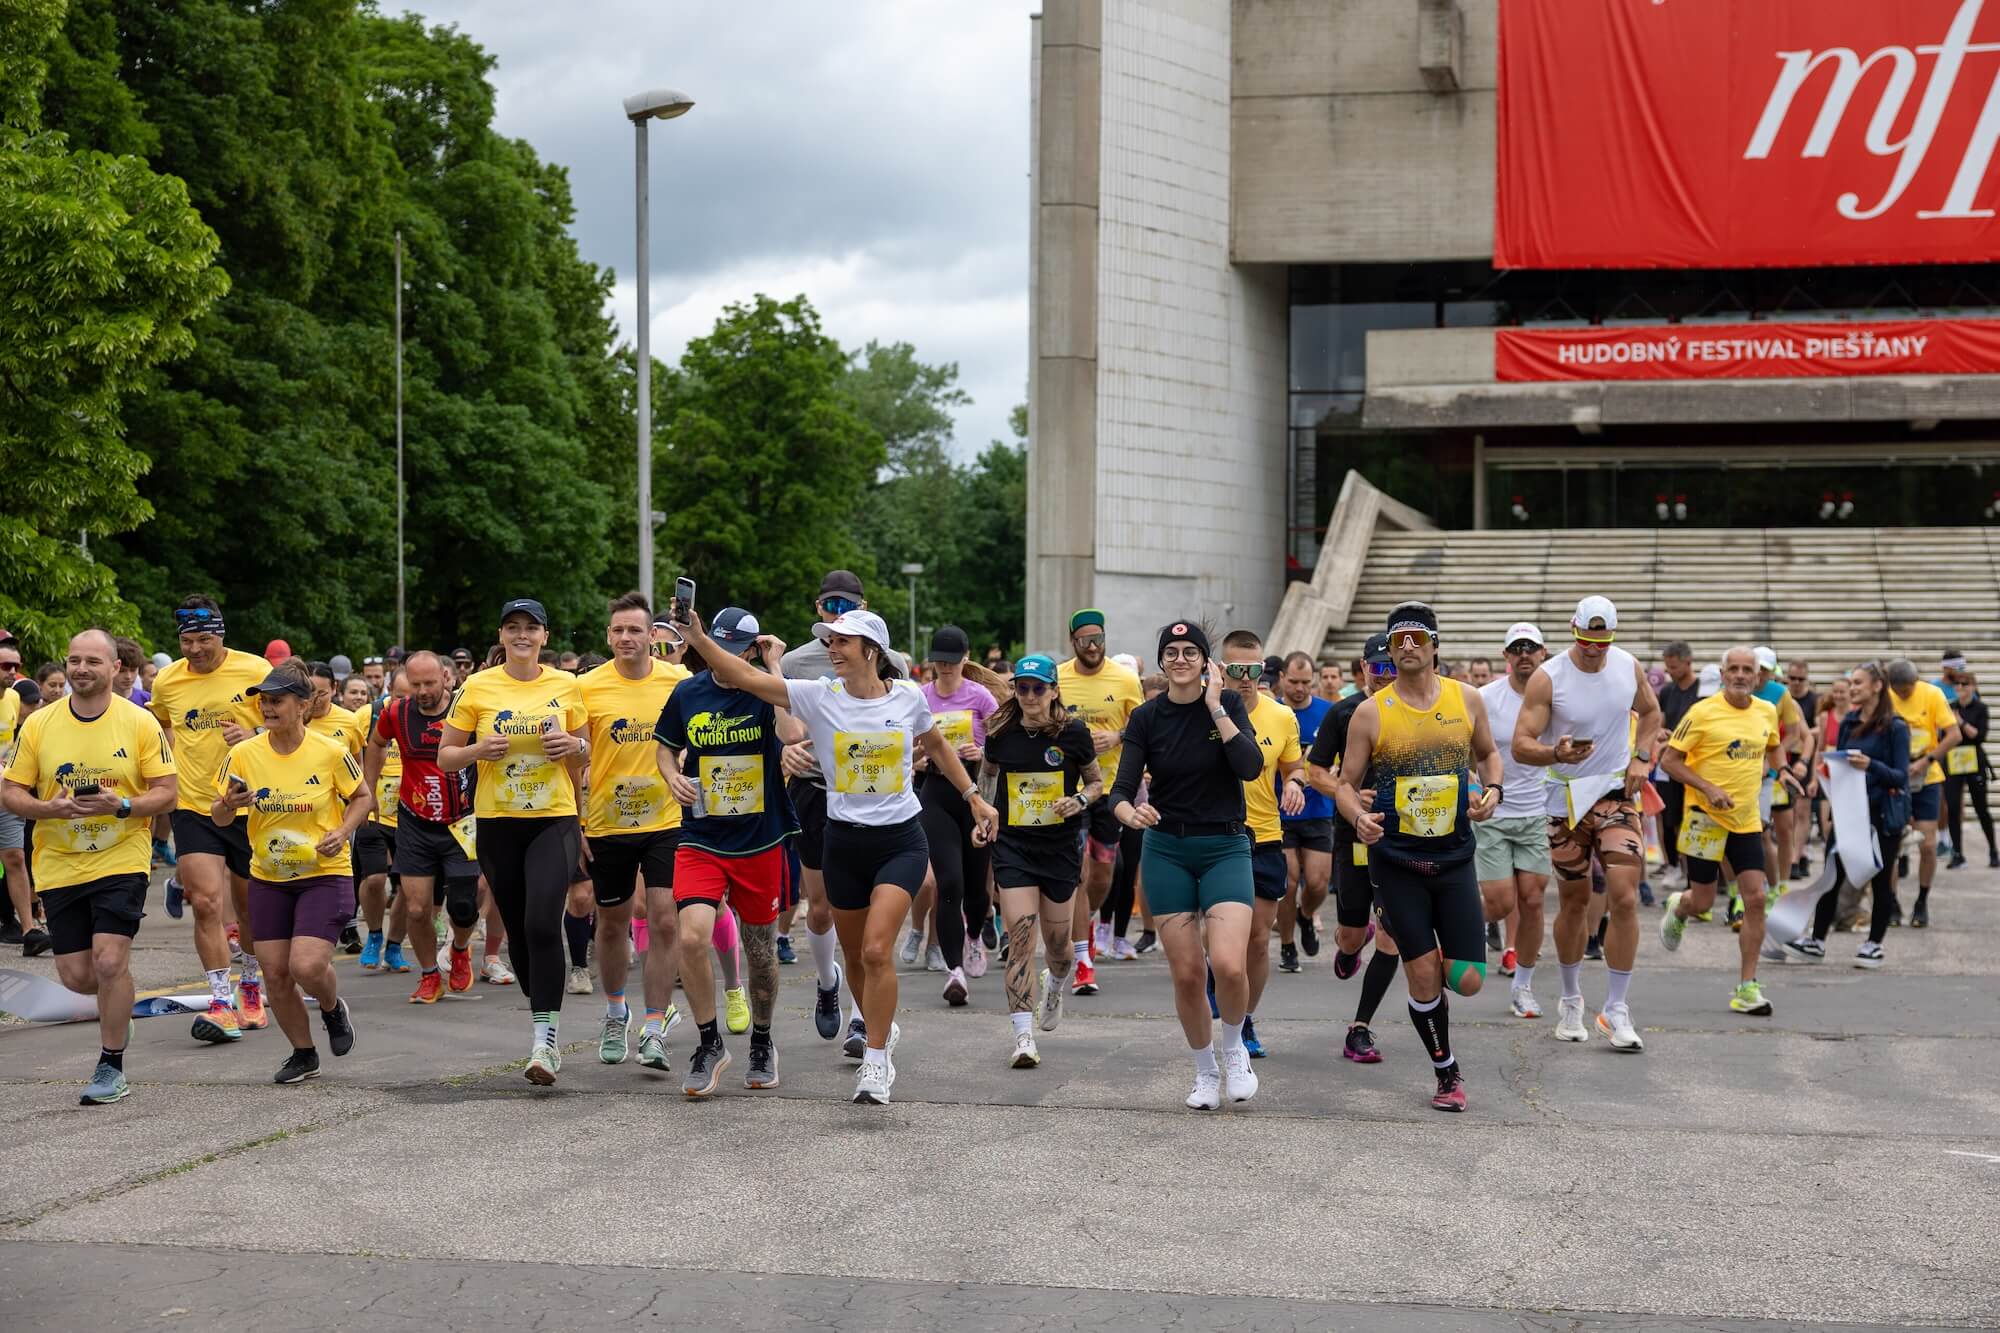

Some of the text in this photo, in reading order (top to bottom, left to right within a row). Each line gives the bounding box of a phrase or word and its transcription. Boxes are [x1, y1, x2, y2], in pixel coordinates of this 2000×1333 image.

[1558, 331, 1929, 364] HUDOBNÝ FESTIVAL PIEŠŤANY
[853, 763, 886, 775] 81881
[508, 781, 545, 793] 110387
[711, 781, 754, 794] 247036
[615, 799, 650, 810] 90563
[1409, 806, 1448, 818] 109993
[73, 823, 108, 834] 89456
